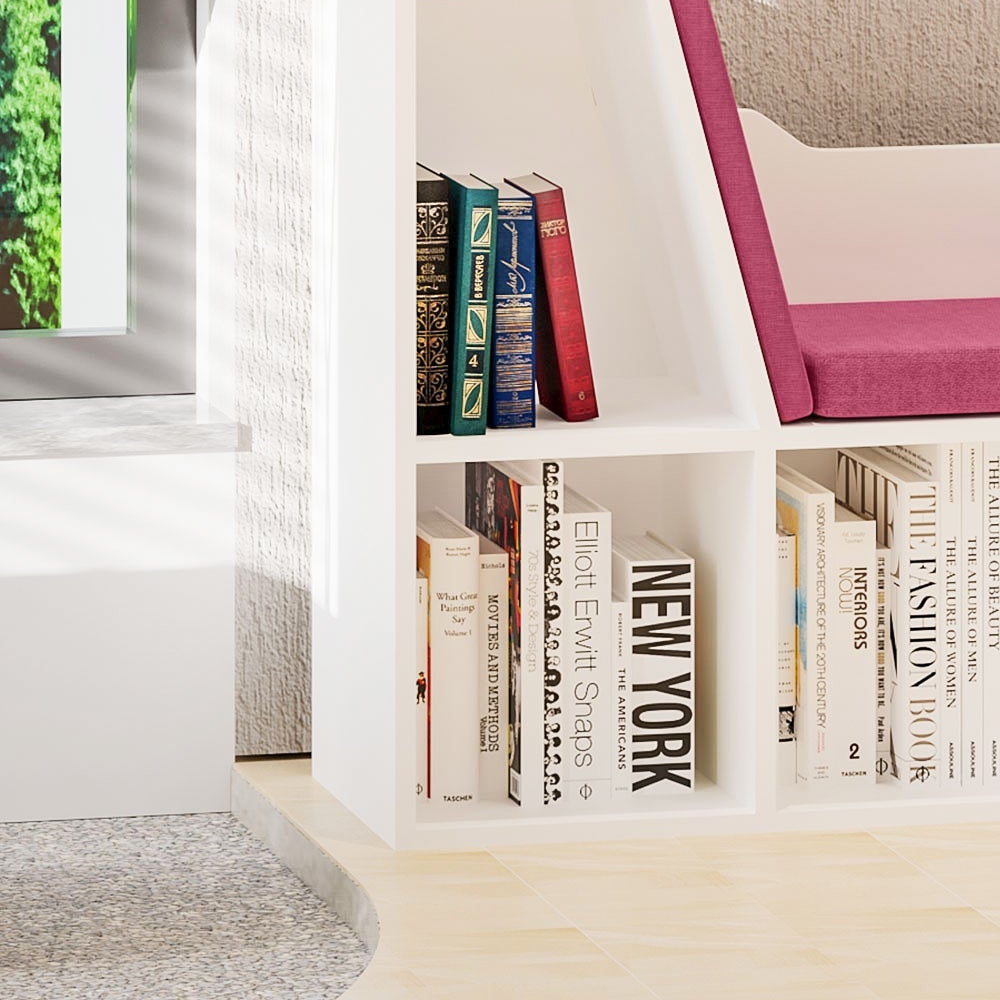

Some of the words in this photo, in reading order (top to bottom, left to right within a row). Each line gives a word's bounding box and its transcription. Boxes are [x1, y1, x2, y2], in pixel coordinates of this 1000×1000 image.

[468, 354, 478, 367] 4
[988, 456, 1000, 490] THE
[816, 503, 826, 547] VISIONARY
[909, 485, 937, 550] THE
[988, 494, 1000, 557] ALLURE
[528, 551, 539, 572] 70s
[574, 520, 599, 589] Elliott
[946, 537, 957, 566] THE
[967, 536, 977, 566] THE
[988, 561, 1000, 582] OF
[526, 574, 539, 607] Style
[816, 548, 826, 617] ARCHITECTURE
[946, 569, 957, 627] ALLURE
[967, 569, 977, 627] ALLURE
[440, 603, 475, 613] Paintings
[452, 615, 466, 625] Say
[488, 594, 499, 651] MOVIES
[528, 610, 539, 621] &
[632, 563, 692, 659] NEW
[816, 618, 826, 631] OF
[854, 567, 868, 650] INTERIORS
[909, 557, 937, 689] FASHION
[988, 586, 1000, 651] BEAUTY
[526, 623, 539, 672] Design
[574, 599, 599, 672] Erwitt
[816, 633, 826, 651] THE
[946, 629, 957, 648] OF
[967, 629, 977, 647] OF
[488, 654, 499, 684] AND
[618, 668, 626, 692] THE
[816, 653, 826, 680] 20TH
[946, 651, 957, 709] WOMEN
[967, 649, 977, 683] MEN
[488, 686, 499, 753] METHODS
[569, 681, 599, 768] Snaps
[816, 681, 826, 728] CENTURY
[480, 716, 488, 747] Volume
[618, 696, 626, 770] AMERICANS
[632, 671, 693, 792] YORK
[849, 743, 860, 760] 2
[909, 698, 937, 784] BOOK
